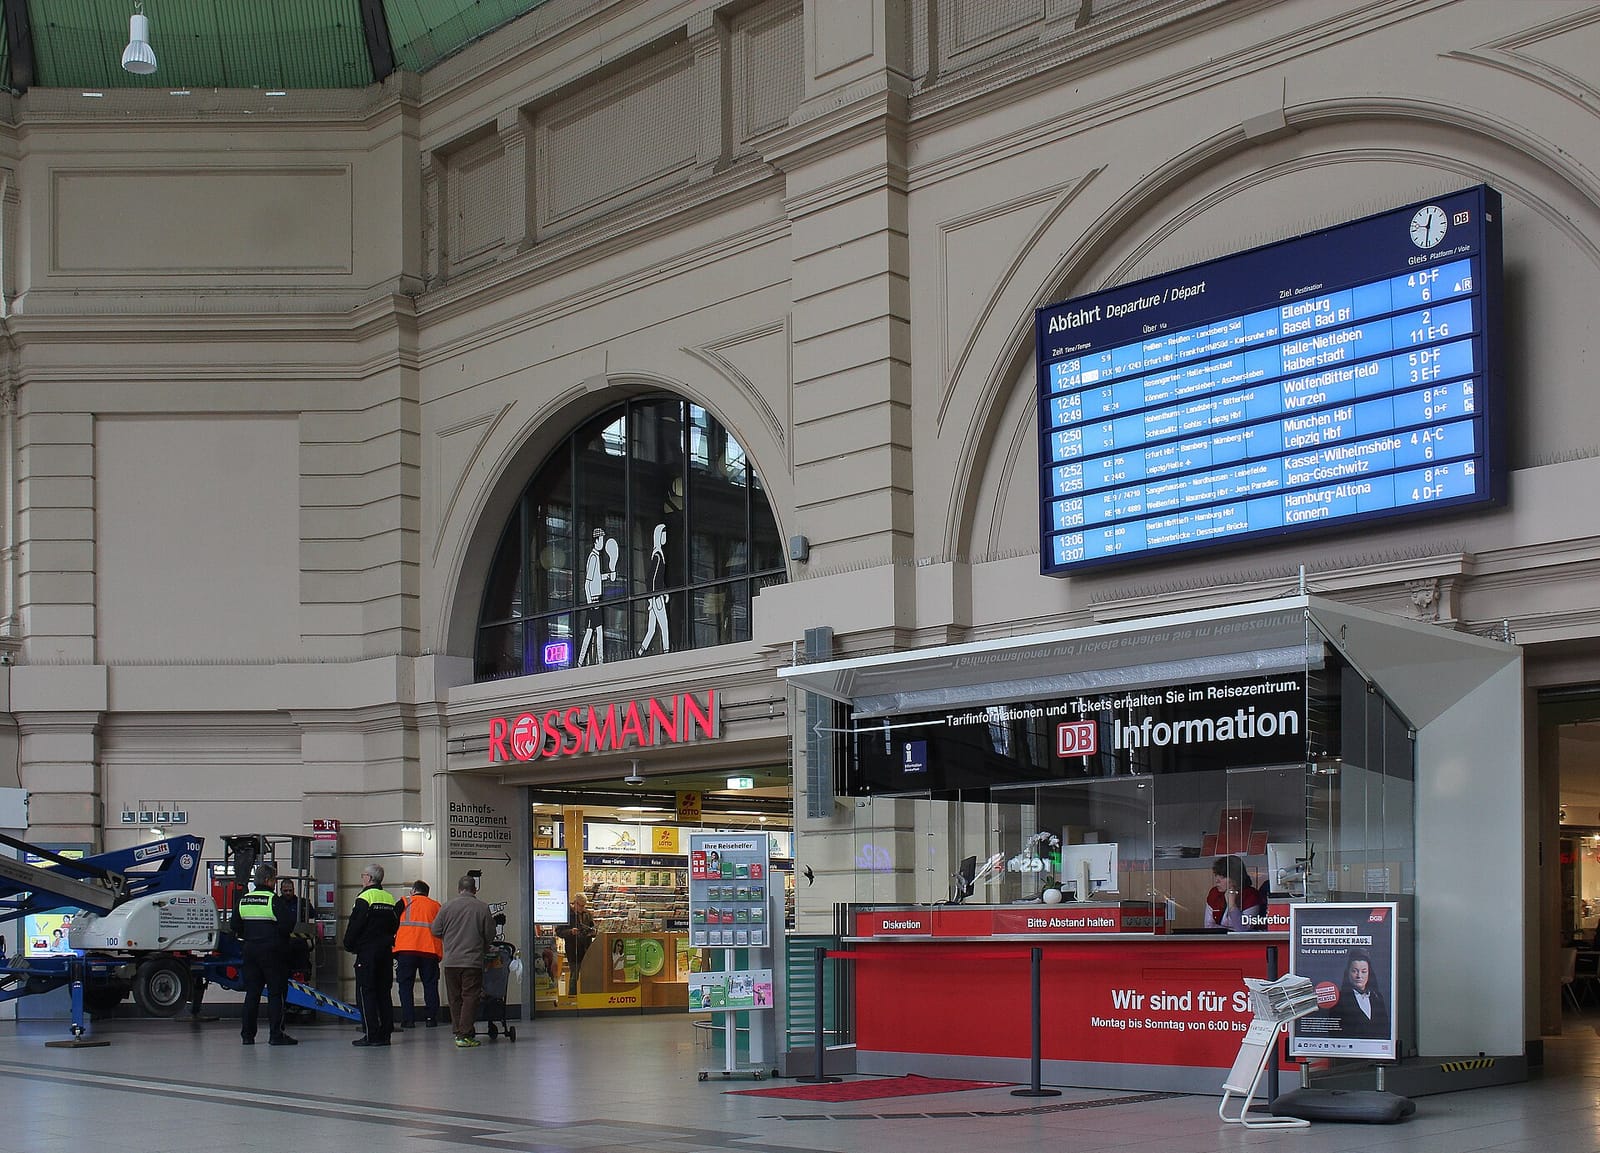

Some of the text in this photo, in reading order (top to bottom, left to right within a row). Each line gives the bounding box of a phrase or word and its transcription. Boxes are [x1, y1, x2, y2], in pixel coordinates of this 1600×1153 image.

[1454, 212, 1469, 225] DB
[1408, 254, 1427, 265] Gleis
[1407, 269, 1439, 287] 4 D-F
[1279, 283, 1323, 298] Ziel Destination
[1422, 288, 1429, 300] 6
[1049, 281, 1205, 334] Abfahrt Departure Départ
[1282, 299, 1330, 319] Eilenburg
[1282, 308, 1350, 335] Basel Bad Bf
[1422, 312, 1430, 324] 2
[1143, 323, 1157, 334] Über
[1229, 322, 1241, 330] Süd
[1411, 324, 1448, 343] 11 E-G
[1283, 330, 1363, 356] Halle-Nietleben
[1052, 347, 1064, 357] Zeit
[1410, 348, 1441, 366] 5 D-F
[1056, 360, 1080, 375] 12:38
[1284, 354, 1344, 372] Halberstadt
[1284, 362, 1379, 393] Wolfen(Bitterfeld)
[1410, 365, 1440, 382] 3 E-F
[1057, 375, 1081, 390] 12:44
[1284, 392, 1326, 409] Wurzen
[1423, 387, 1447, 402] 8 A-G
[1057, 396, 1080, 410] 12:46
[1058, 411, 1082, 425] 12:49
[1424, 403, 1447, 419] 9 D-F
[1285, 408, 1352, 432] München Hbf
[1058, 431, 1082, 445] 12:50
[1285, 426, 1342, 449] Leipzig Hbf
[1411, 428, 1444, 445] 4 A-C
[1059, 444, 1082, 458] 12:51
[1284, 437, 1401, 470] Kassel-Wilhelmshöhe
[1425, 448, 1432, 459] 6
[1059, 465, 1082, 478] 12:52
[1286, 460, 1368, 485] Jena-Göschwitz
[1424, 467, 1448, 482] 8 A-G
[1059, 480, 1083, 494] 12:55
[1285, 482, 1371, 507] Hamburg-Altona
[1412, 484, 1444, 500] 4 D-F
[1059, 499, 1083, 513] 13:02
[1060, 514, 1083, 527] 13:05
[1286, 506, 1328, 522] Könnern
[1060, 534, 1083, 548] 13:06
[1060, 548, 1083, 562] 13:07
[546, 645, 567, 662] OPEN
[946, 680, 1300, 727] Tarifinformationen und Tickets erhalten Sie im Reisezentrum.
[488, 689, 713, 762] ROSSMANN
[1061, 707, 1298, 752] DB Information
[450, 802, 495, 813] Bahnhofs-
[450, 814, 507, 825] management
[450, 828, 511, 841] Bundespolizei
[187, 843, 200, 851] 100
[883, 920, 921, 929] Diskretion
[1027, 917, 1114, 928] Bitte Abstand halten
[106, 938, 118, 946] 100
[1112, 989, 1254, 1013] Wir sind für Si
[1092, 1018, 1126, 1032] Montag
[1128, 1018, 1142, 1029] bis
[1145, 1018, 1185, 1033] Sonntag
[1188, 1020, 1205, 1031] von
[1209, 1019, 1228, 1031] 6:00
[1230, 1019, 1246, 1032] bis
